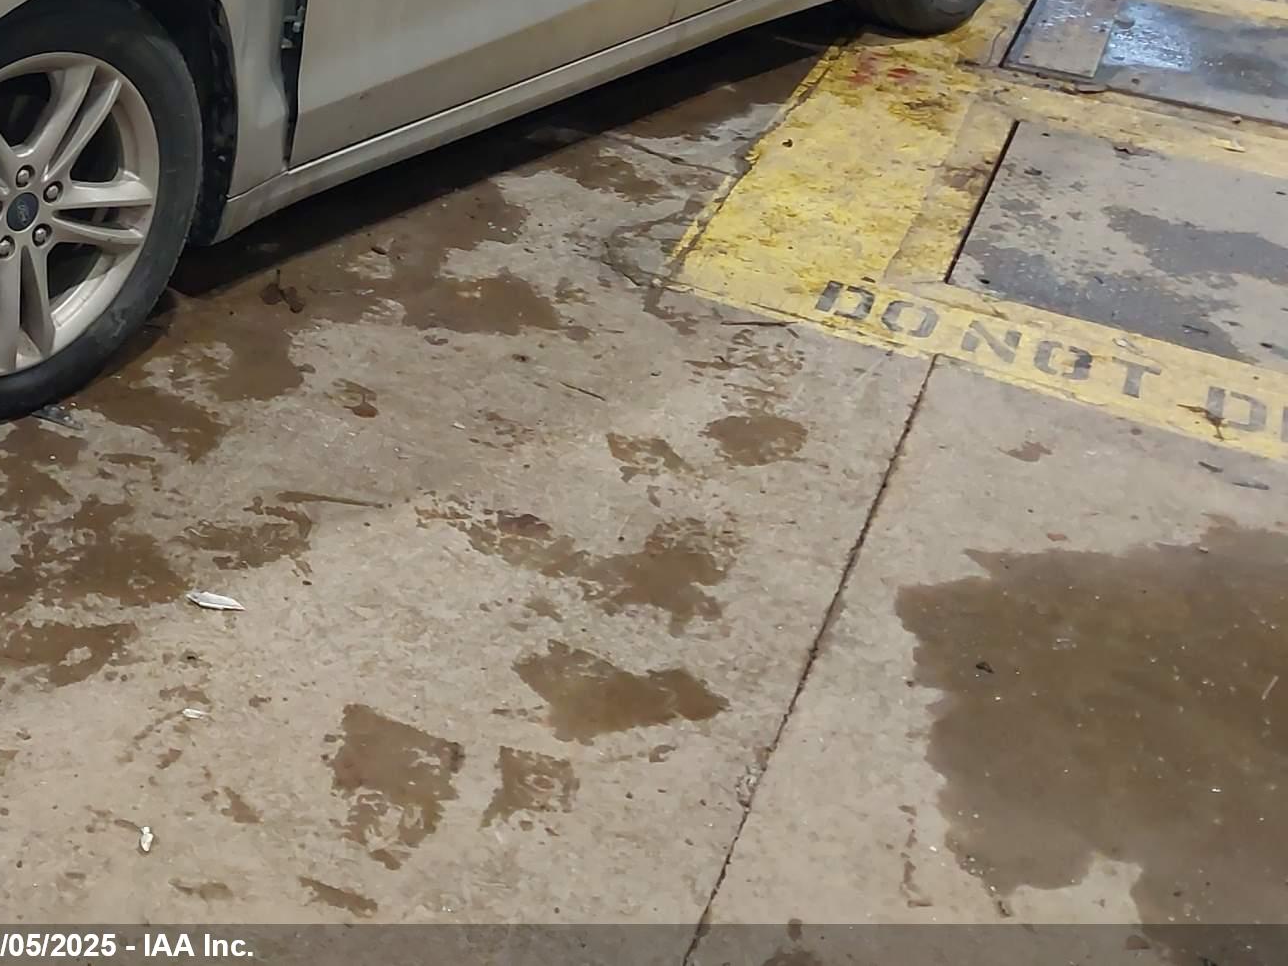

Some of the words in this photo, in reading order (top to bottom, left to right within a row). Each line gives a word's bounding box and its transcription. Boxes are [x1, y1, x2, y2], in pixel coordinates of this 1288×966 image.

[814, 280, 940, 338] DO
[961, 320, 1162, 399] NOT
[1206, 386, 1288, 444] D
